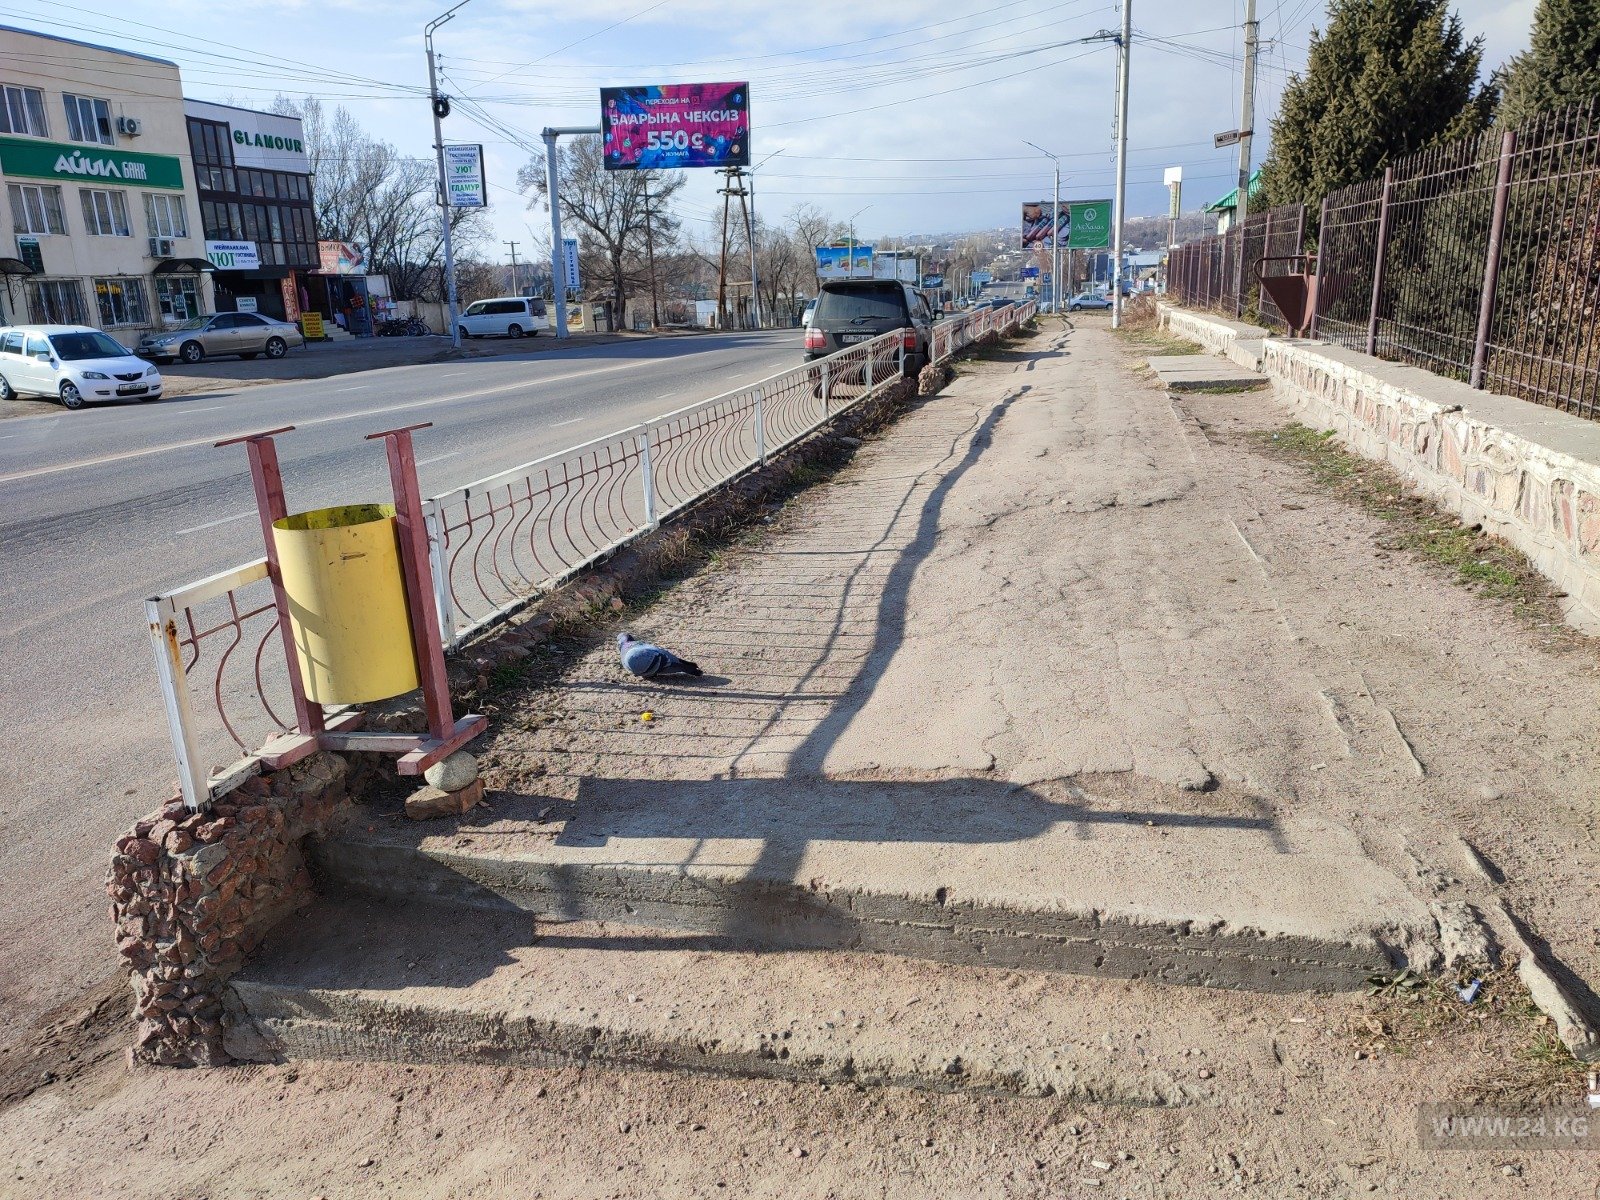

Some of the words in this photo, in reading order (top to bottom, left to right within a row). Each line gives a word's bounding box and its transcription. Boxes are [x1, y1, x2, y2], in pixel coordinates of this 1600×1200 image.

[609, 113, 680, 126] БААРЫНА
[684, 109, 739, 123] ЧЕКСИЗ
[233, 129, 303, 153] GLAMOUR
[647, 129, 689, 150] 550
[455, 165, 472, 174] УЮТ
[451, 183, 480, 192] ГЛАМУР
[208, 251, 236, 267] УЮТ
